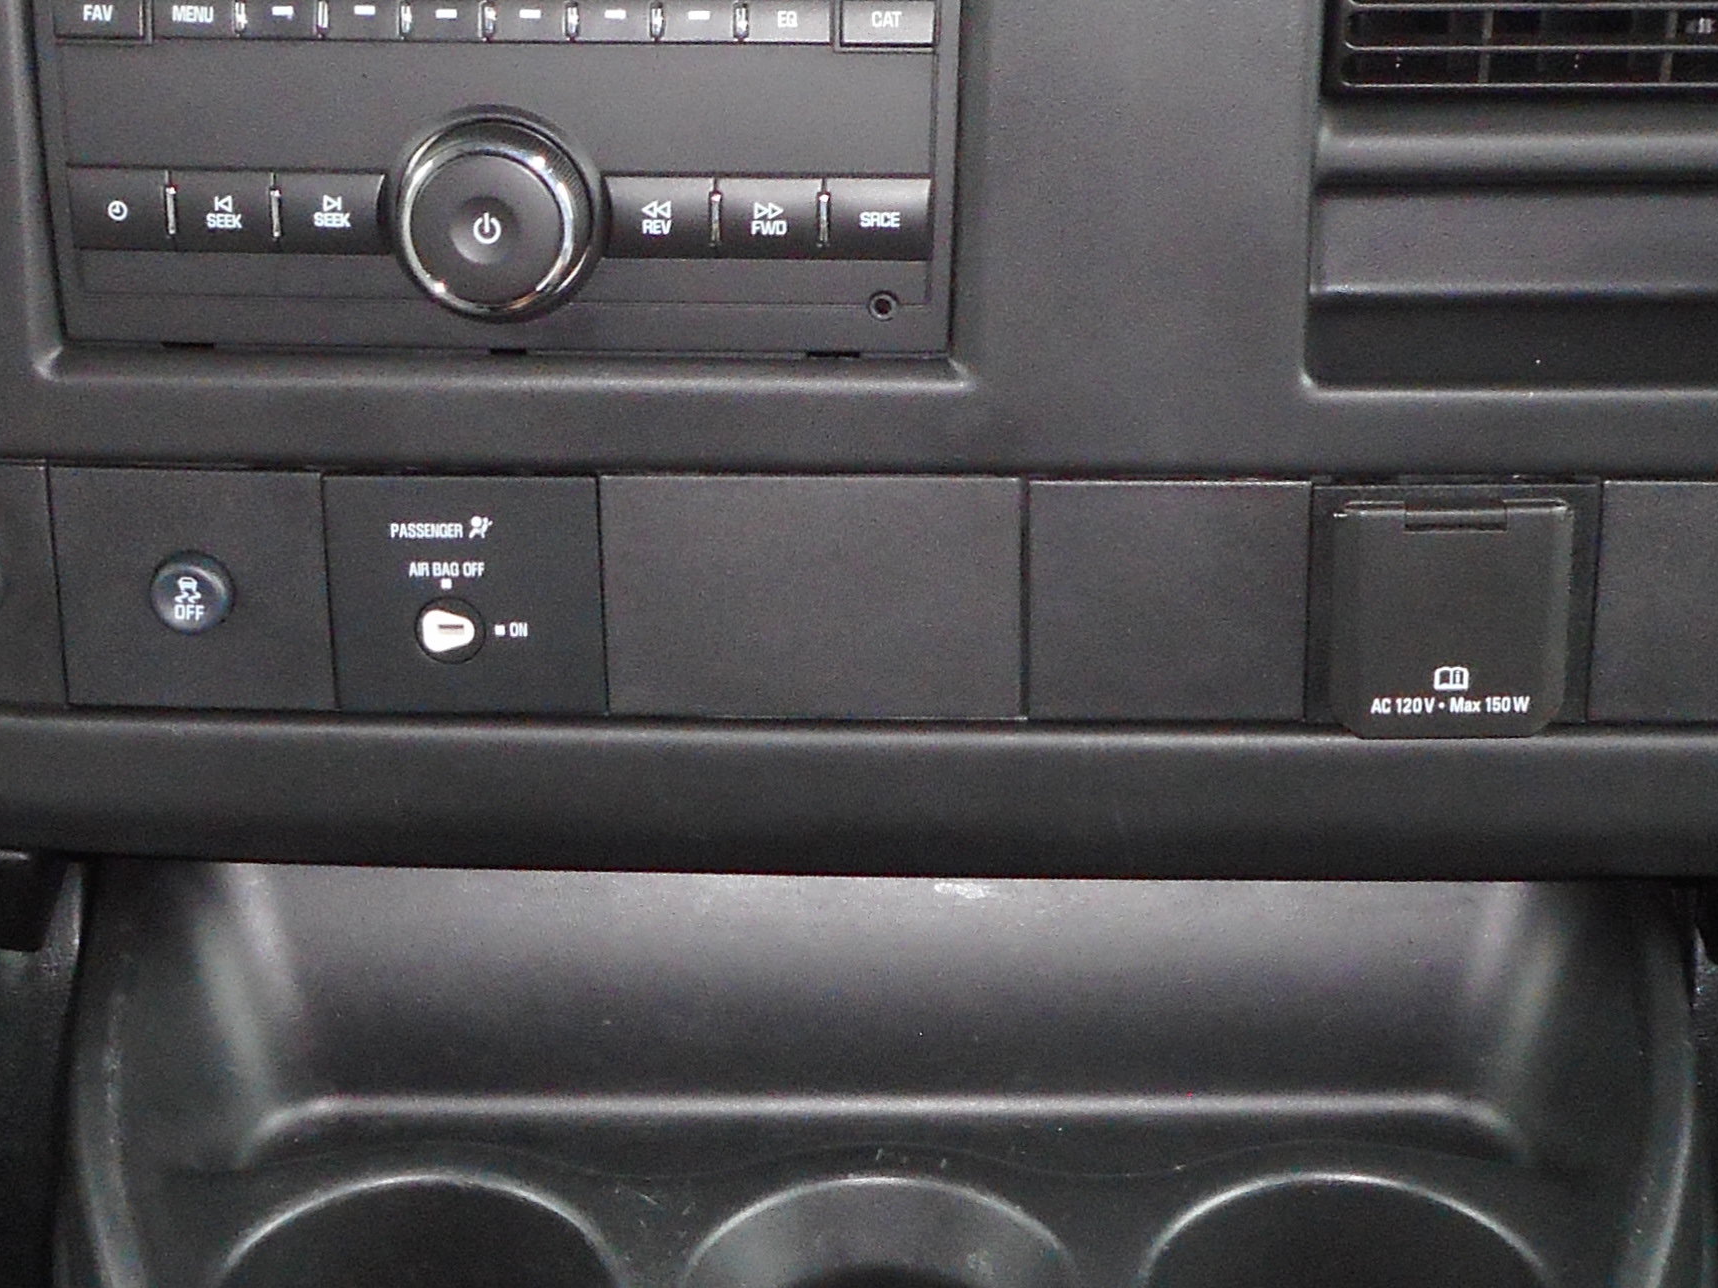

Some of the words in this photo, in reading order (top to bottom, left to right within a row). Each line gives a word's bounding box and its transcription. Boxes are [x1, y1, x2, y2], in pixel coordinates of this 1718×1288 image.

[83, 4, 113, 21] FAV
[172, 5, 213, 23] MENU
[777, 11, 799, 29] EQ
[871, 11, 902, 28] CAT
[206, 213, 242, 229] SEEK
[314, 212, 350, 228] SEEK
[642, 220, 672, 235] REV
[751, 220, 788, 235] FWD
[859, 212, 900, 228] SRCE
[391, 523, 463, 538] PASSENGER
[409, 562, 429, 576] AIR
[432, 562, 459, 577] BAG
[463, 562, 484, 577] OFF
[174, 604, 204, 620] OFF
[510, 622, 528, 637] ON
[1371, 698, 1391, 713] AC
[1450, 697, 1481, 712] Max
